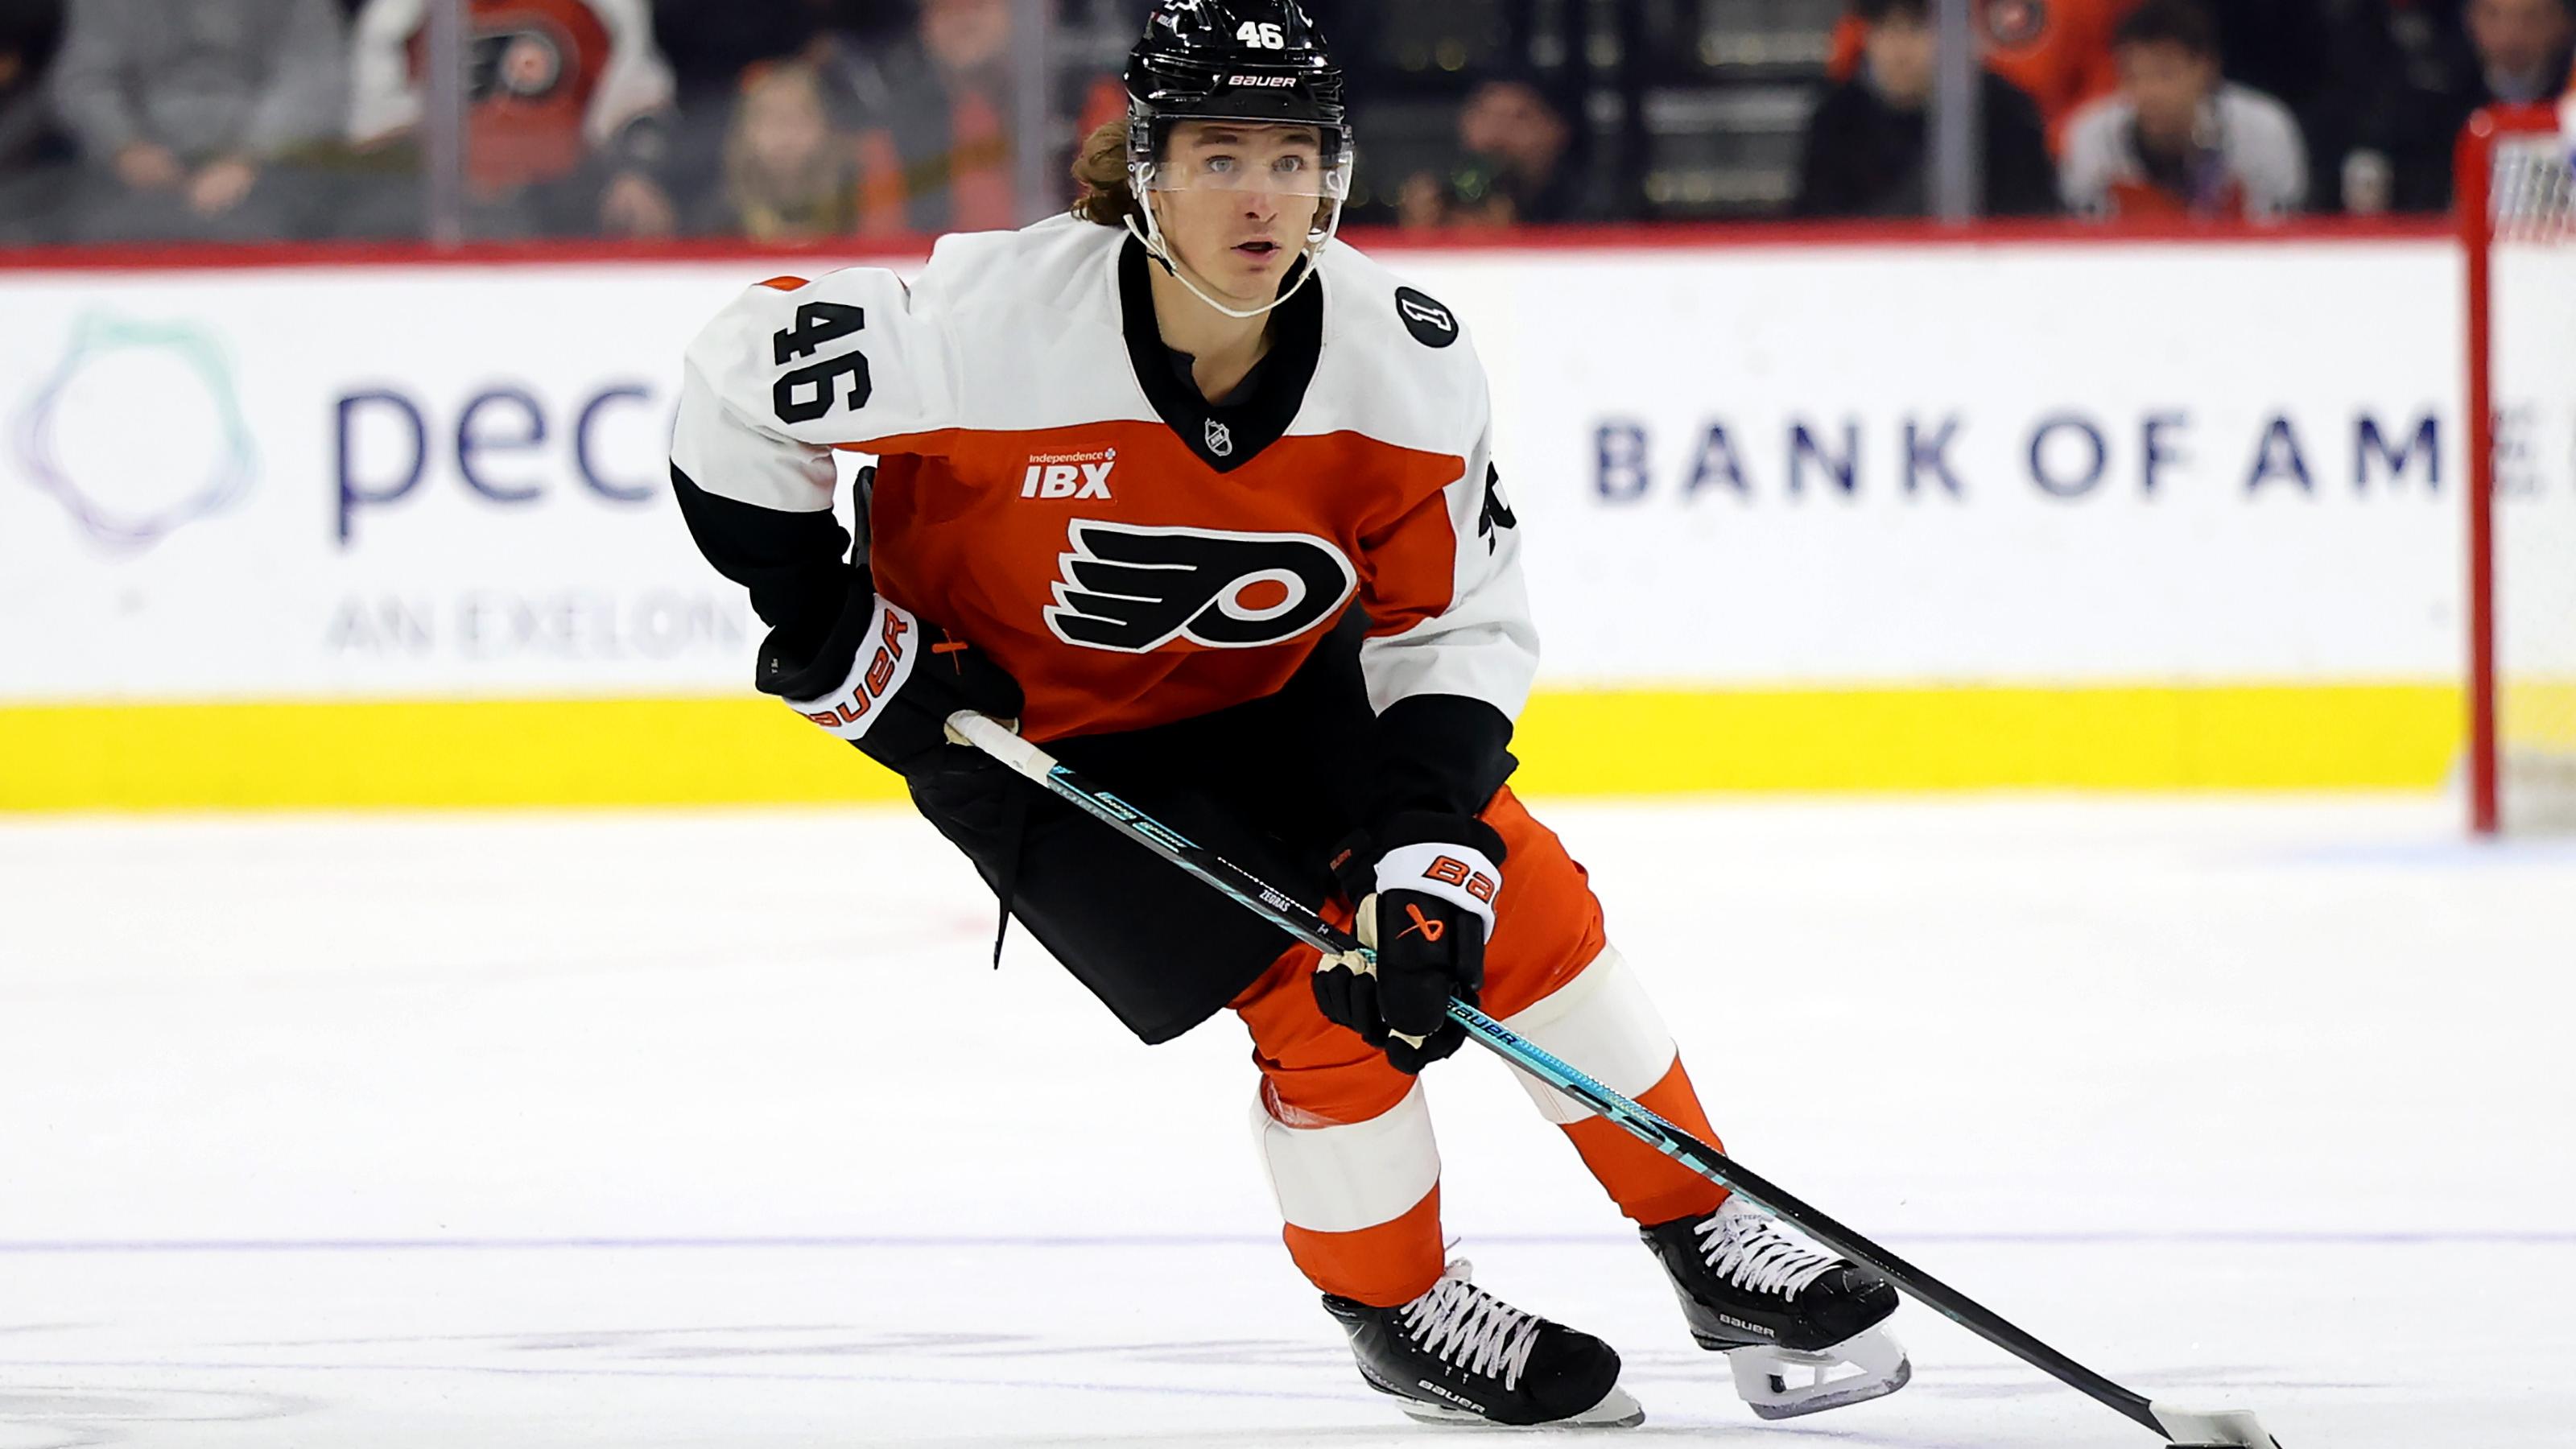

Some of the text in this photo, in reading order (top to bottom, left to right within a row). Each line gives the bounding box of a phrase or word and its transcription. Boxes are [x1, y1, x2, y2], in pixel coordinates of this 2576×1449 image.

[1236, 21, 1284, 50] 46
[774, 301, 872, 425] 46
[334, 382, 679, 544] pec
[1020, 460, 1115, 499] IBX
[1029, 452, 1104, 464] Independence
[1594, 414, 1966, 497] BANK
[2026, 409, 2188, 497] OF
[324, 588, 747, 658] AN EXELON
[808, 608, 909, 727] AUER
